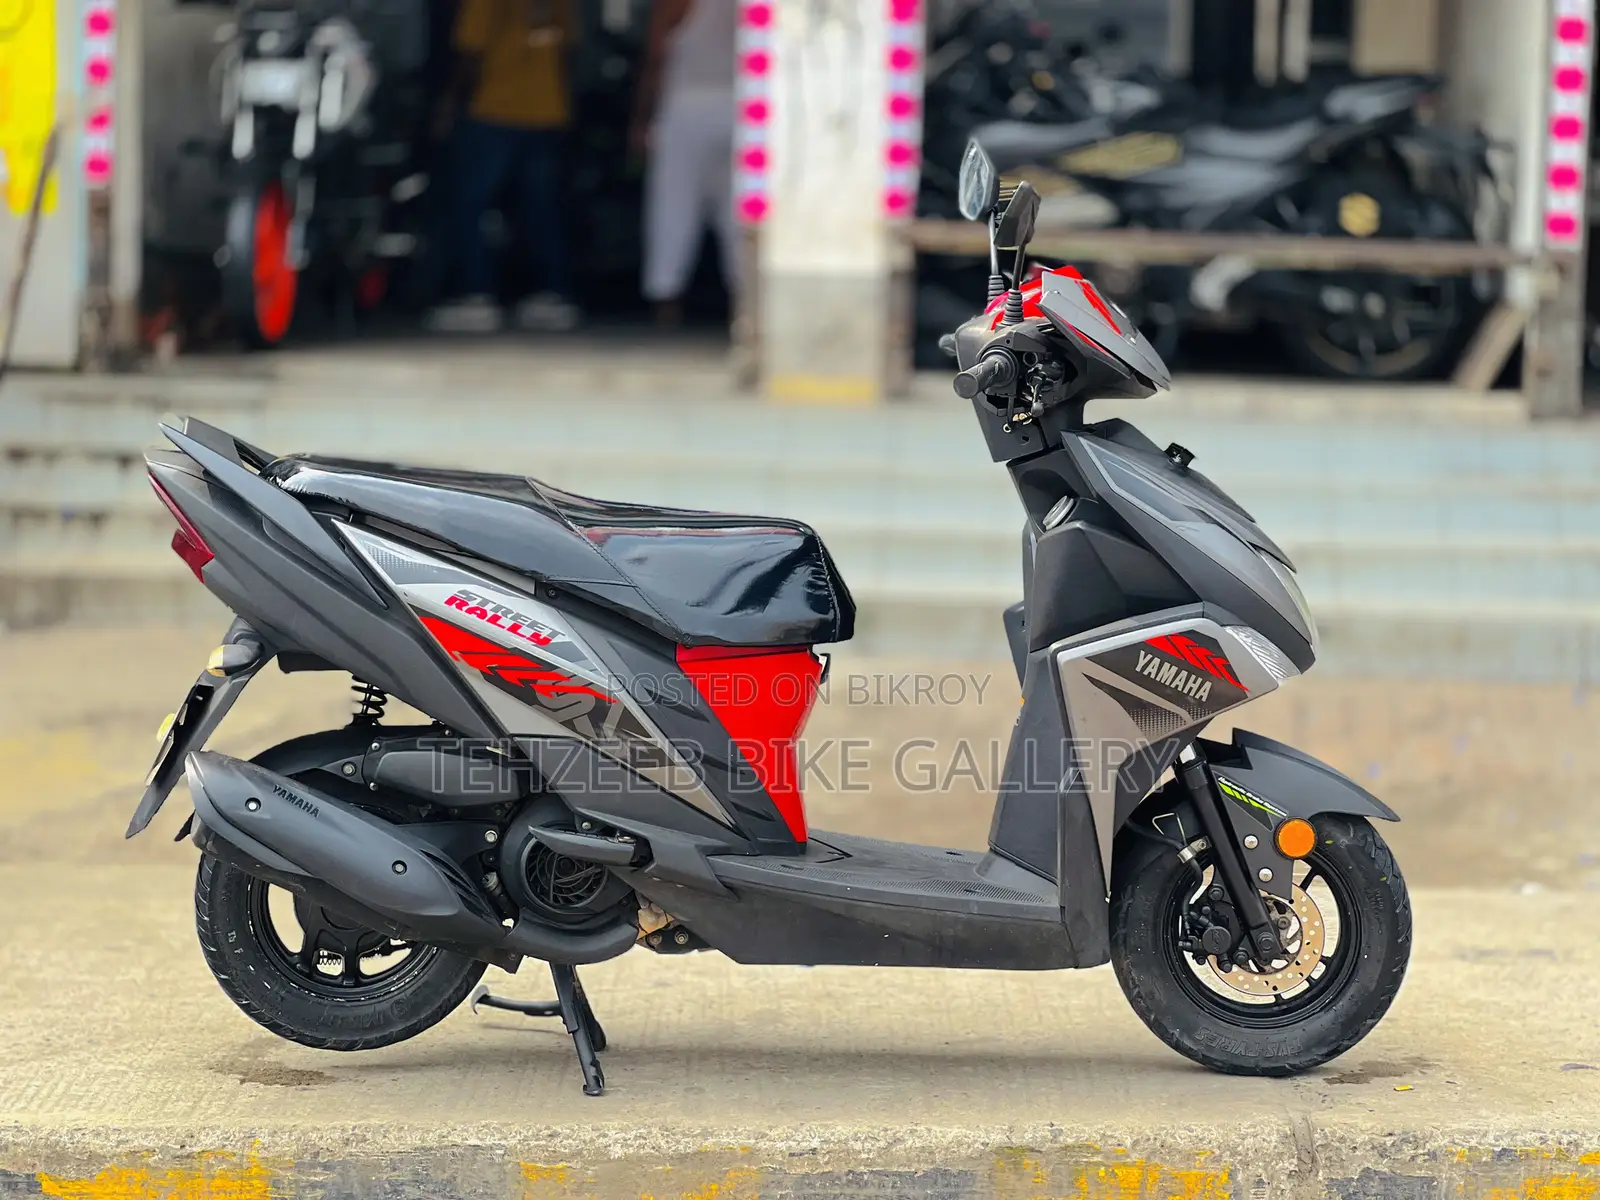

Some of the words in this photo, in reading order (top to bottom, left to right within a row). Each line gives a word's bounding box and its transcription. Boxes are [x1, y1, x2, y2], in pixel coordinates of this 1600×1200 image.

[444, 595, 552, 646] RALLY
[453, 589, 566, 640] STREET
[1135, 649, 1213, 702] YAMAHA
[272, 784, 321, 818] YAMAHA
